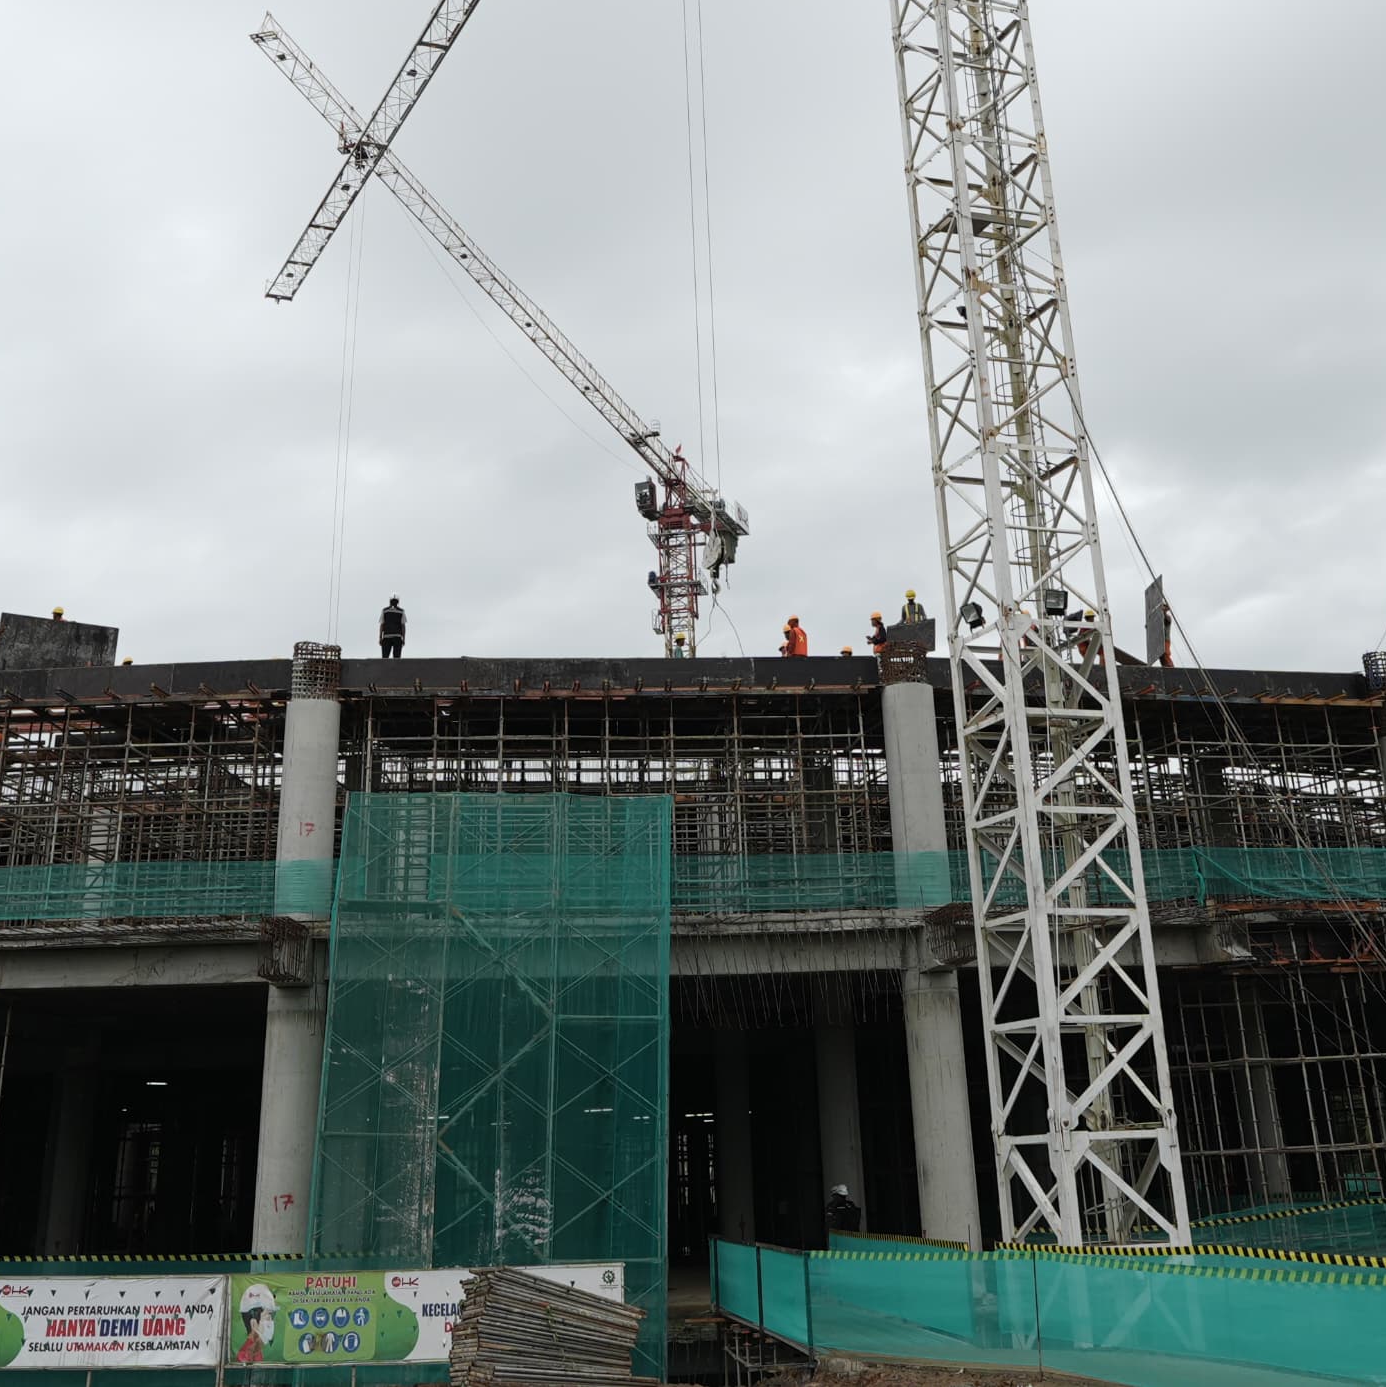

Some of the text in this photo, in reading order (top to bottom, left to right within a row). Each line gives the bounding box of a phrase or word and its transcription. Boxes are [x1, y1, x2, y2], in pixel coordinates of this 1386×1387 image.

[299, 821, 315, 838] 17
[274, 1194, 294, 1212] 17
[306, 1276, 356, 1288] PATUHI
[21, 1304, 213, 1315] JANGAN PERTARUHKAN NYAWA ANDA
[46, 1318, 186, 1337] HANYA DEMI UANG
[29, 1342, 63, 1352] SELALU
[66, 1342, 124, 1352] UTAMAKAN
